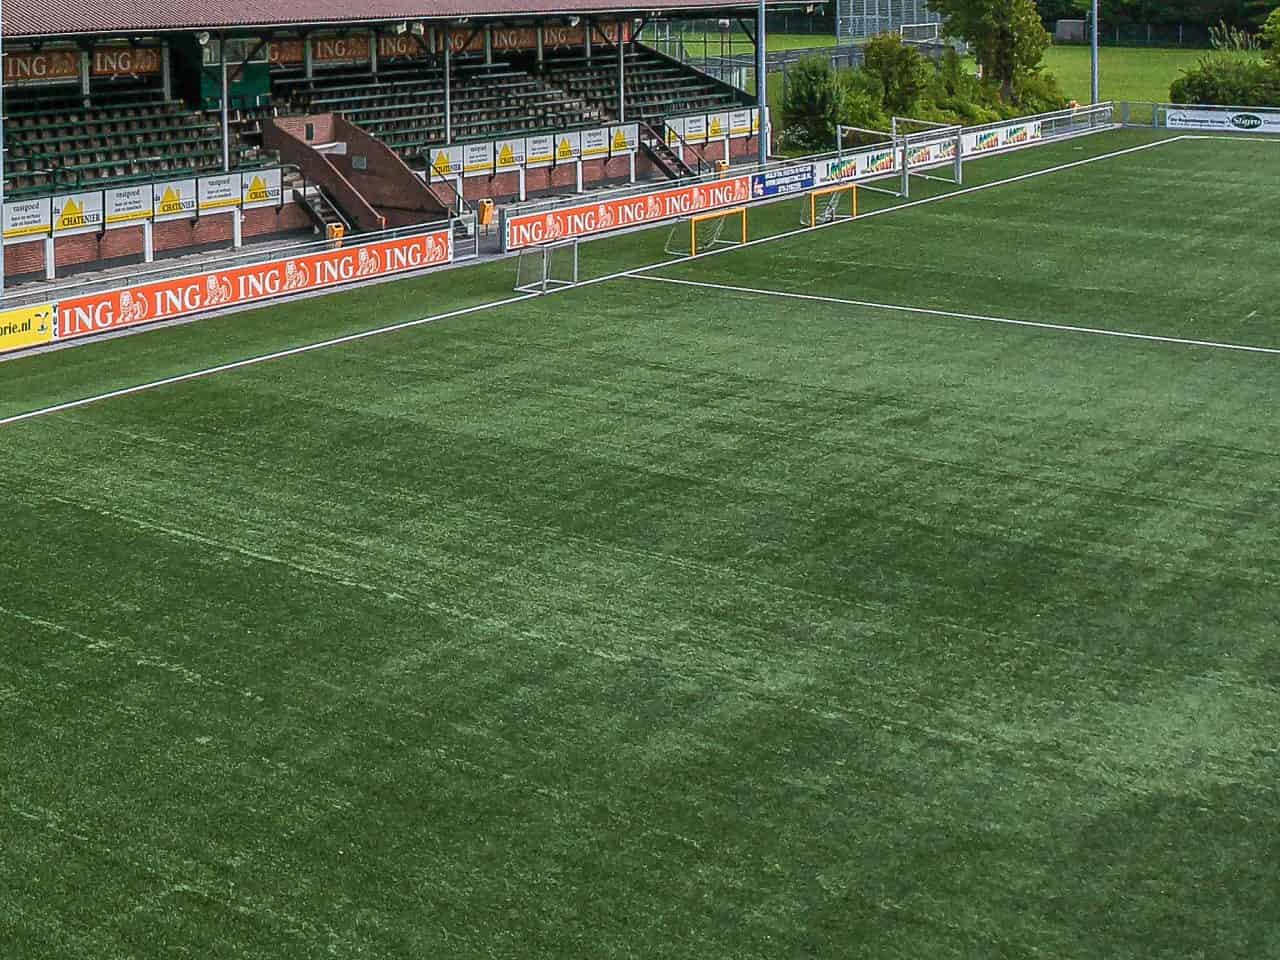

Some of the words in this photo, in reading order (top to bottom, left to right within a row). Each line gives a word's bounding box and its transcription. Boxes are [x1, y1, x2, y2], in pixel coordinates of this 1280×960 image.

[316, 40, 345, 58] ING
[7, 56, 47, 77] ING
[95, 52, 131, 71] ING
[665, 196, 690, 215] ING
[710, 189, 734, 206] ING
[566, 214, 596, 235] ING
[618, 204, 645, 224] ING
[511, 222, 544, 246] ING
[385, 244, 421, 270] ING
[315, 256, 354, 285] ING
[237, 270, 280, 299] ING
[154, 284, 201, 317] ING
[62, 301, 113, 336] ING
